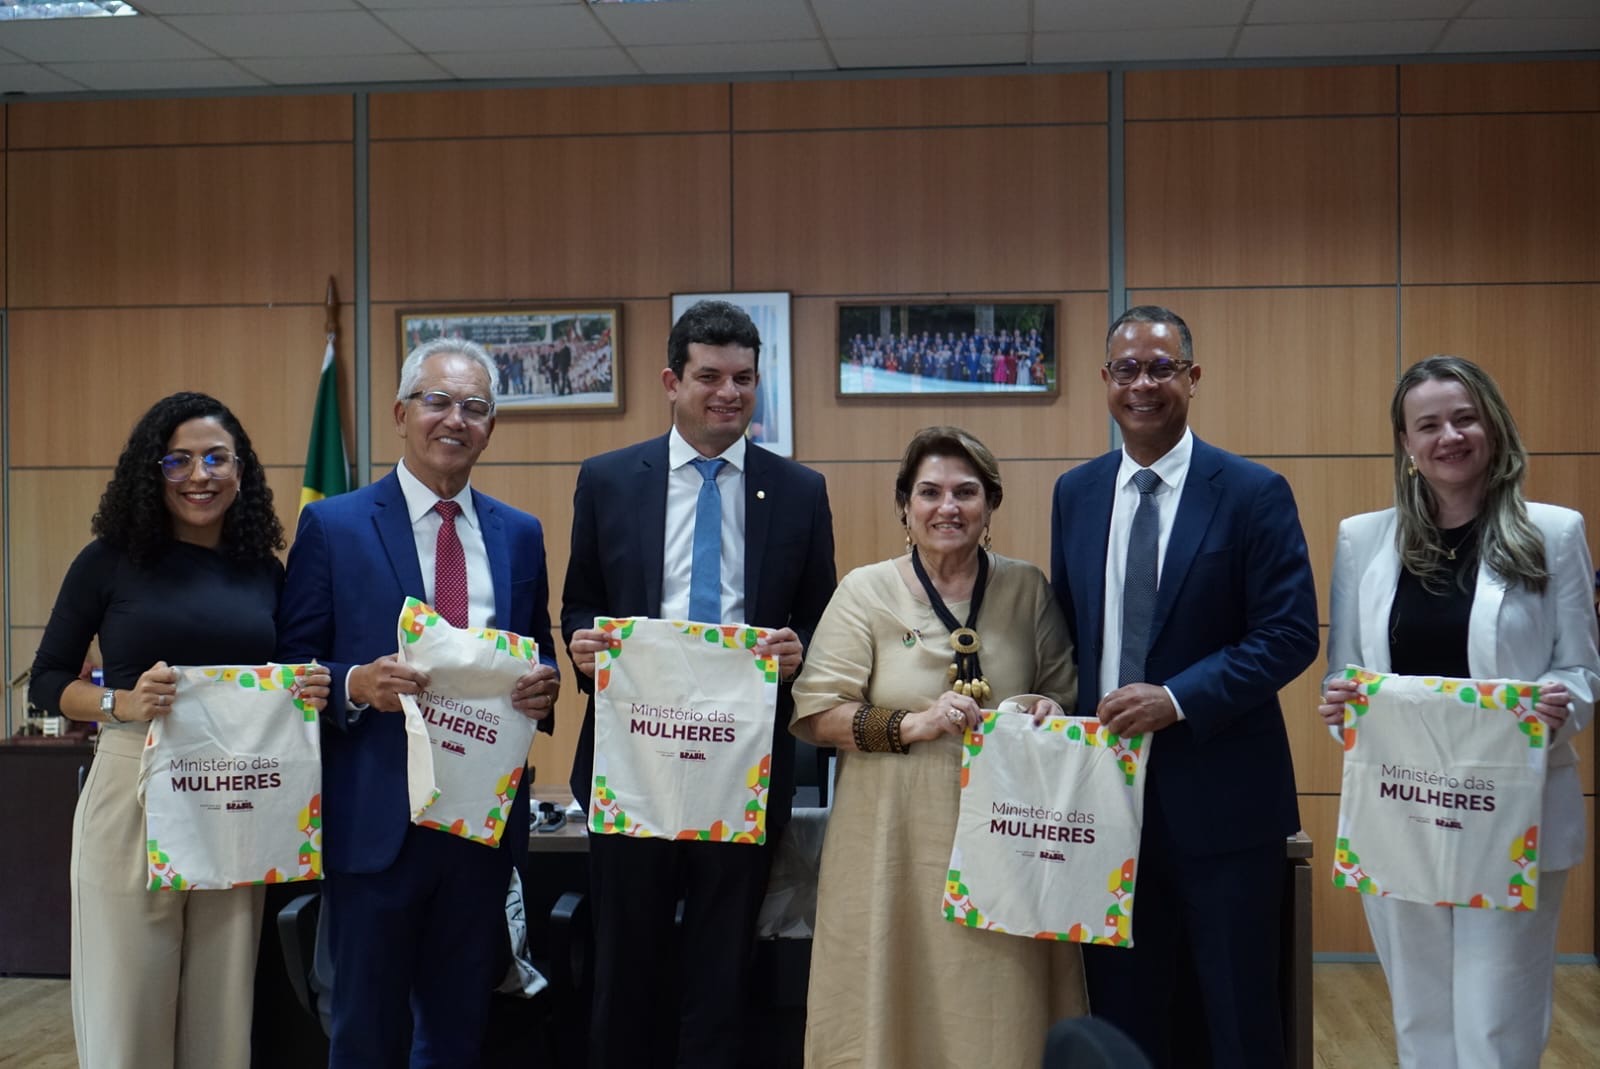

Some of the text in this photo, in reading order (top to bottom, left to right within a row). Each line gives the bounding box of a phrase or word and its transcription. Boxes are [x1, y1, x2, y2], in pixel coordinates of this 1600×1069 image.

[475, 708, 502, 726] das
[631, 703, 736, 724] Ministério das
[630, 719, 736, 742] MULHERES
[169, 756, 280, 772] Ministério das
[679, 752, 707, 761] BRASIL
[171, 773, 282, 792] MULHERES
[1381, 763, 1496, 791] Ministério das
[1380, 782, 1496, 812] MULHERES
[992, 801, 1095, 824] Ministério das
[990, 819, 1096, 844] MULHERES
